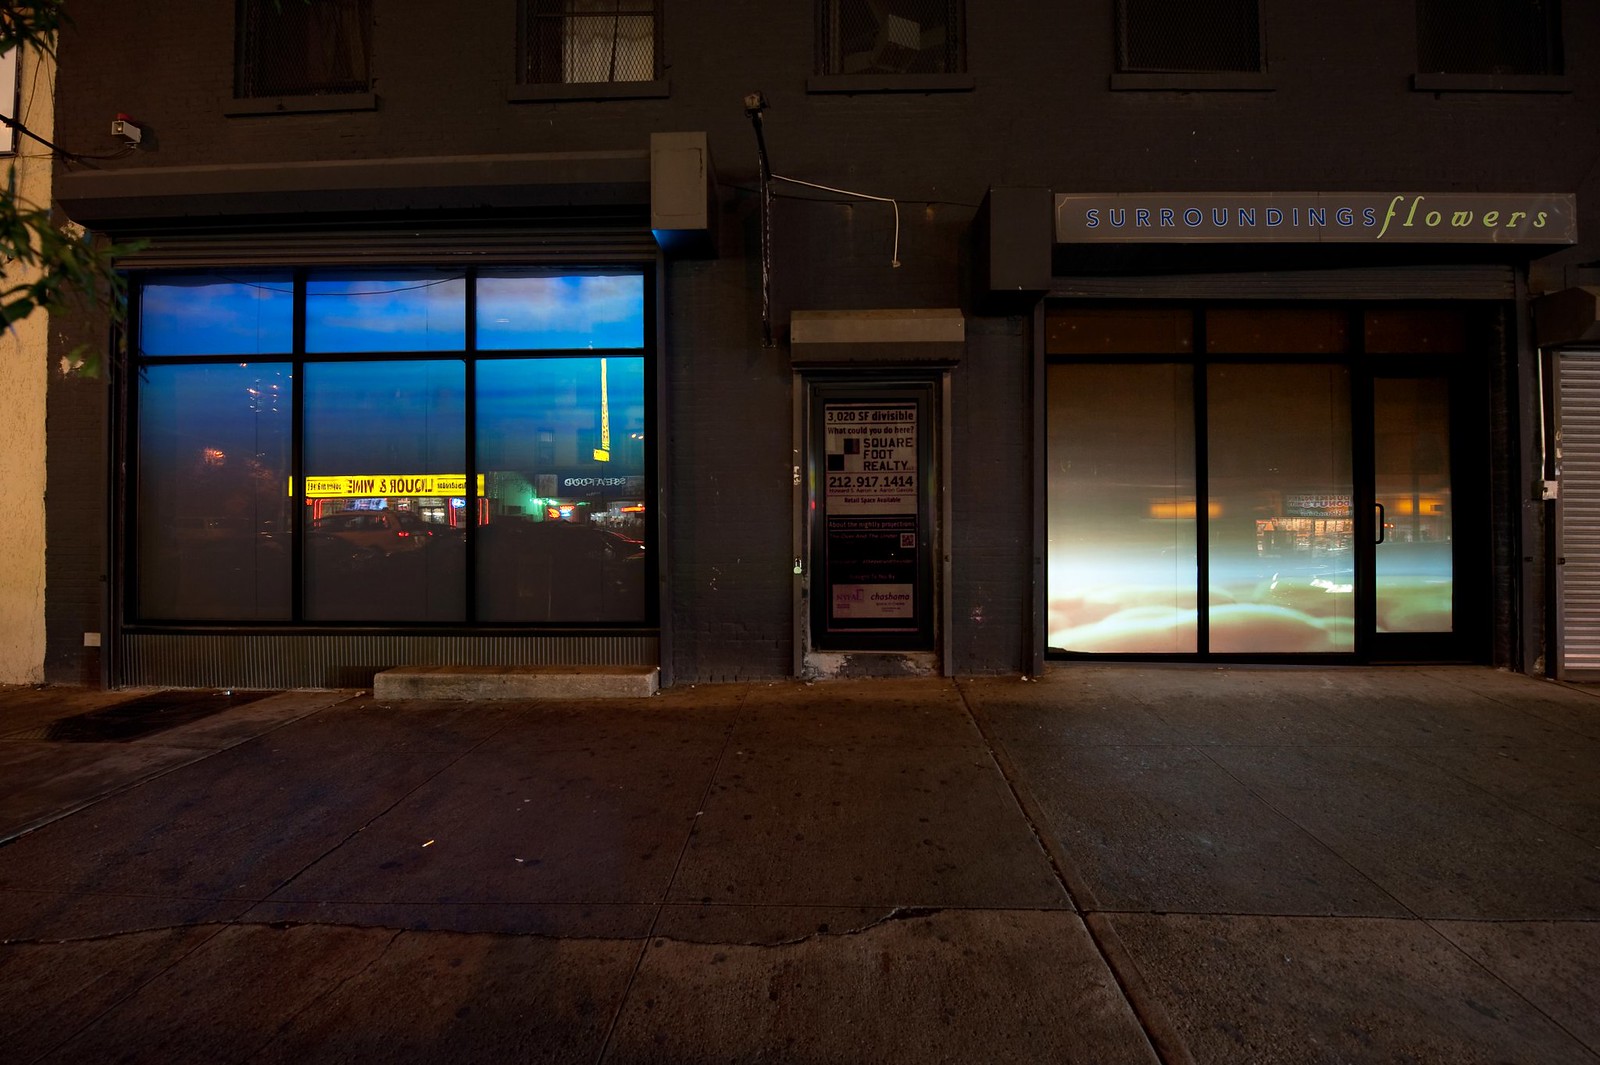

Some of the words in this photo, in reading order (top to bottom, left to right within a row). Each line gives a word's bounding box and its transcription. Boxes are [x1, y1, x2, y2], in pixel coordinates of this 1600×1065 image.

[1085, 207, 1377, 229] SURROUNDINGS
[1376, 195, 1548, 239] flowers
[827, 411, 856, 422] 3,020
[858, 411, 870, 421] SF
[871, 410, 914, 421] divisible
[828, 427, 847, 435] What
[847, 426, 868, 435] could
[869, 427, 882, 436] you
[883, 426, 893, 434] do
[894, 426, 915, 434] here?
[863, 437, 914, 448] SQUARE
[863, 449, 894, 459] FOOT
[863, 461, 908, 471] REALTY
[829, 475, 914, 488] 212.917.1414
